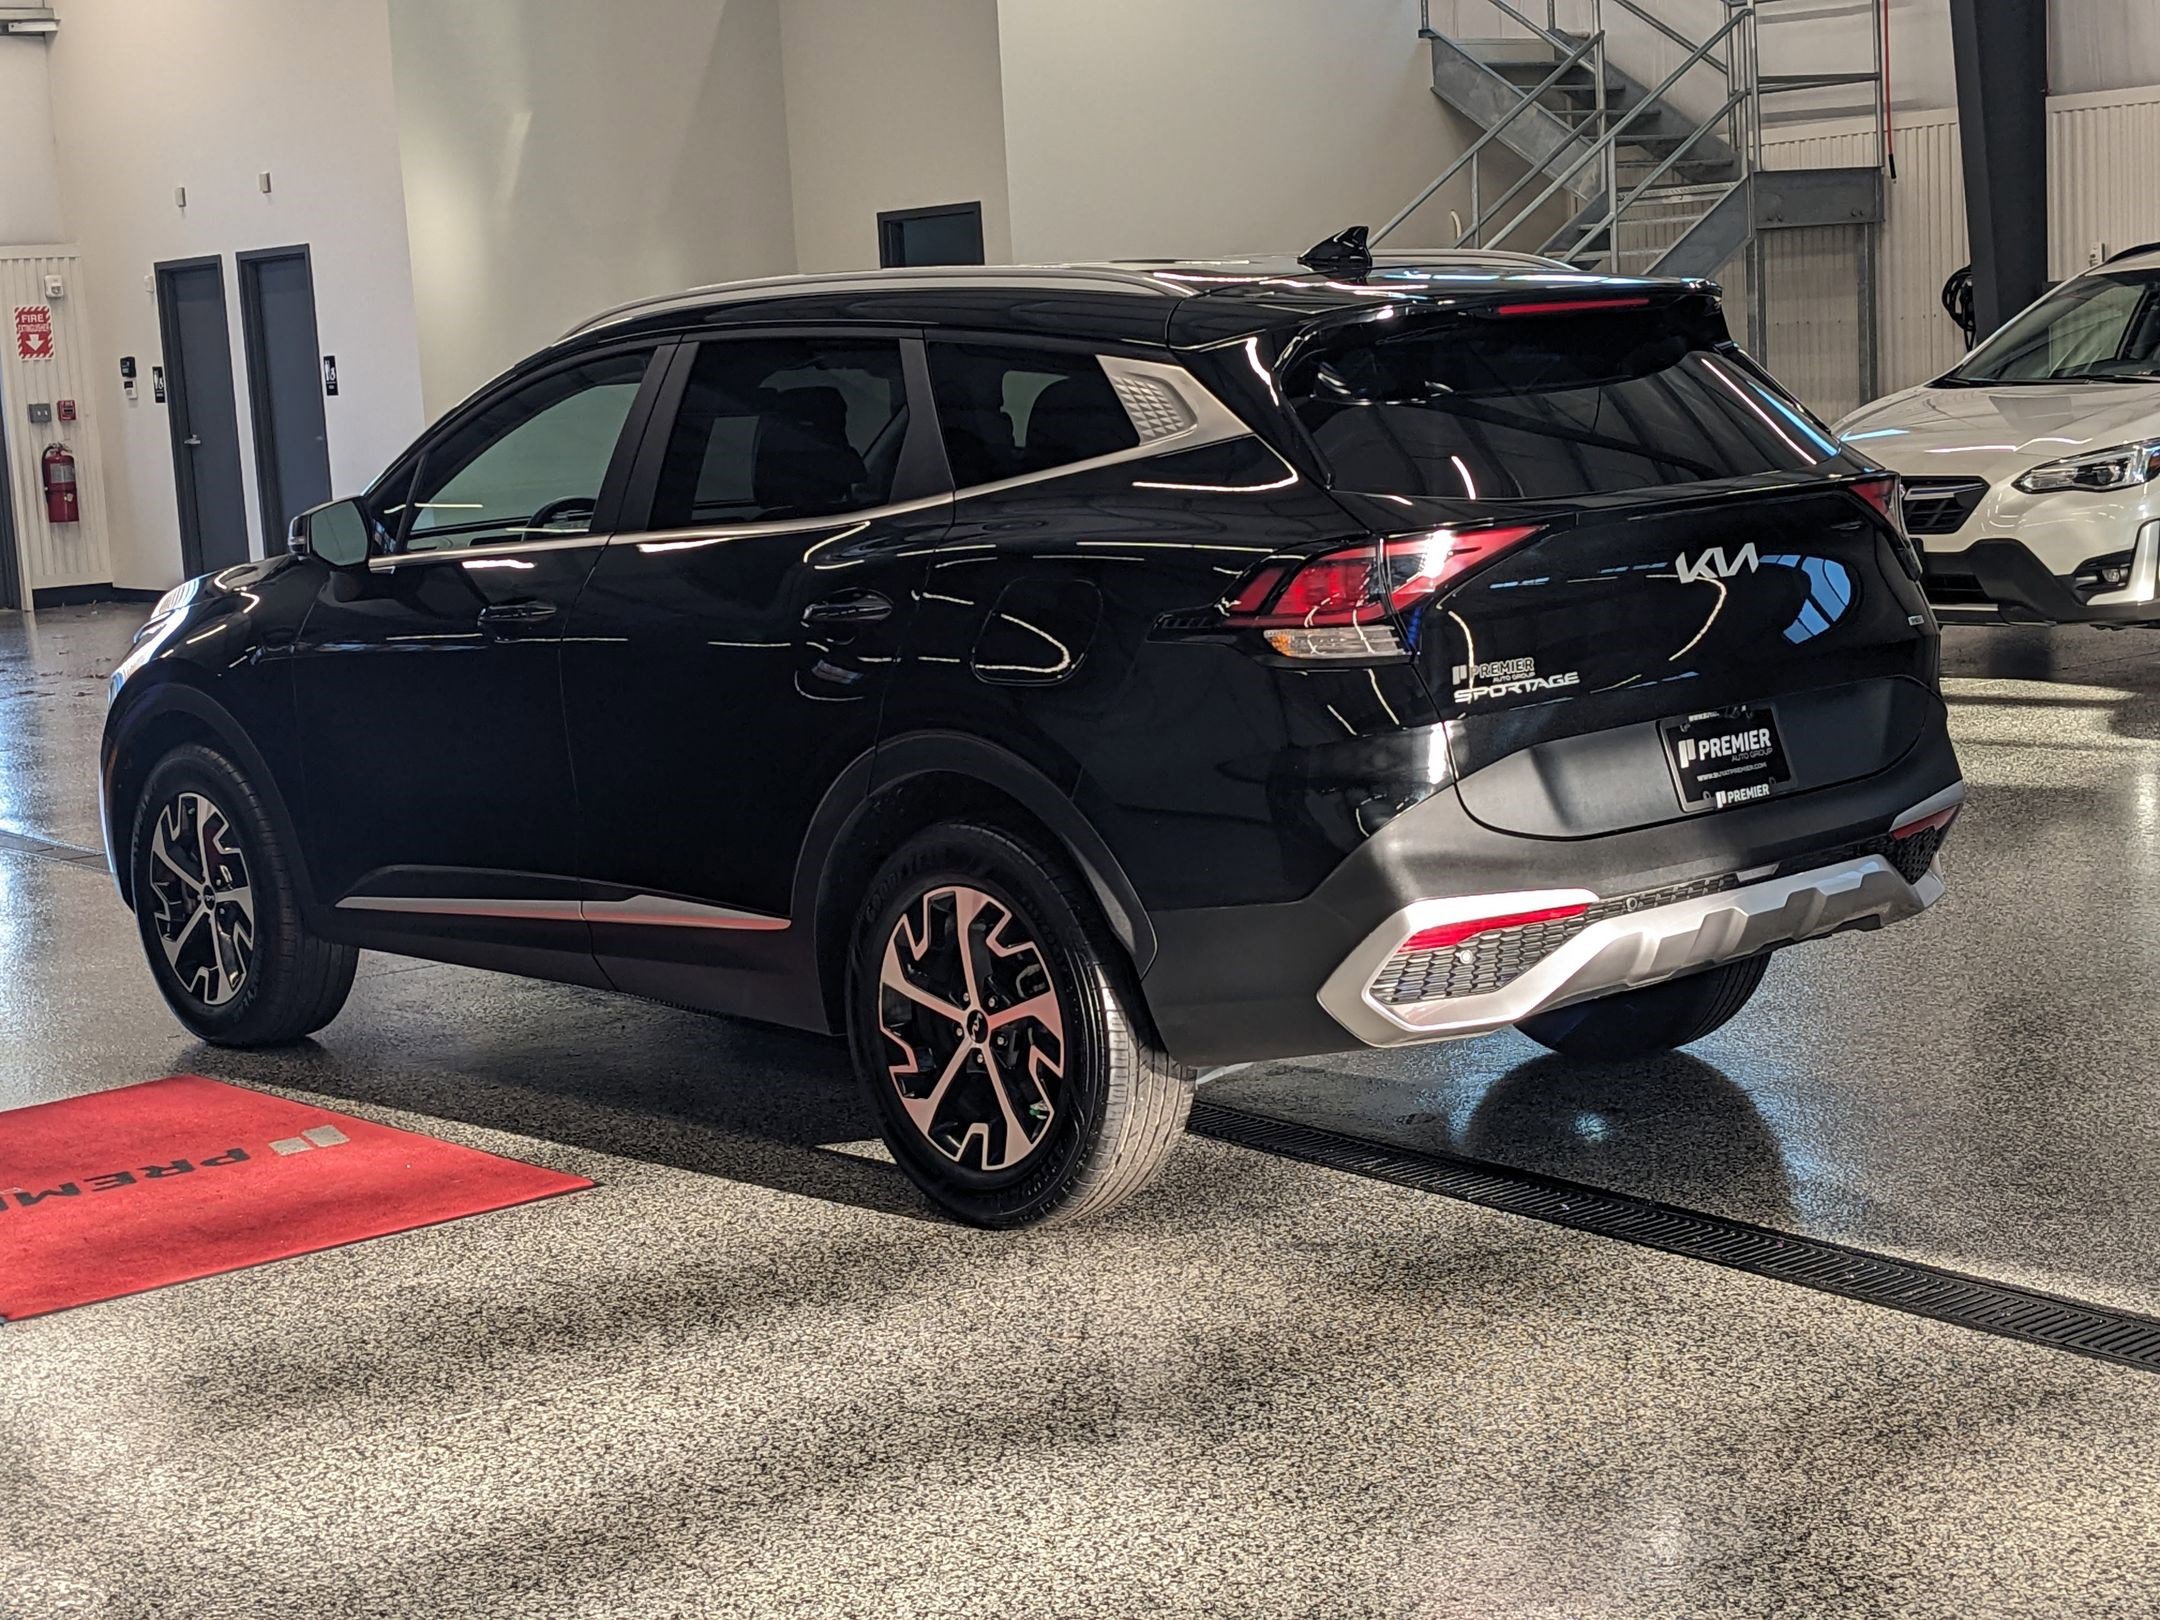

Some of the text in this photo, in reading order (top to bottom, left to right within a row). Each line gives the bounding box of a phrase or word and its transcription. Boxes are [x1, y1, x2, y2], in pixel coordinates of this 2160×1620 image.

[21, 313, 45, 323] FIRE
[1675, 542, 1759, 584] KIA
[1471, 657, 1534, 678] PREMIER
[1492, 671, 1536, 683] AUTO GROUP
[1453, 671, 1580, 703] SPORTAGE
[1698, 728, 1772, 761] PREMIER
[1731, 747, 1773, 762] AUTO GROUP
[1727, 783, 1770, 803] PREMIER
